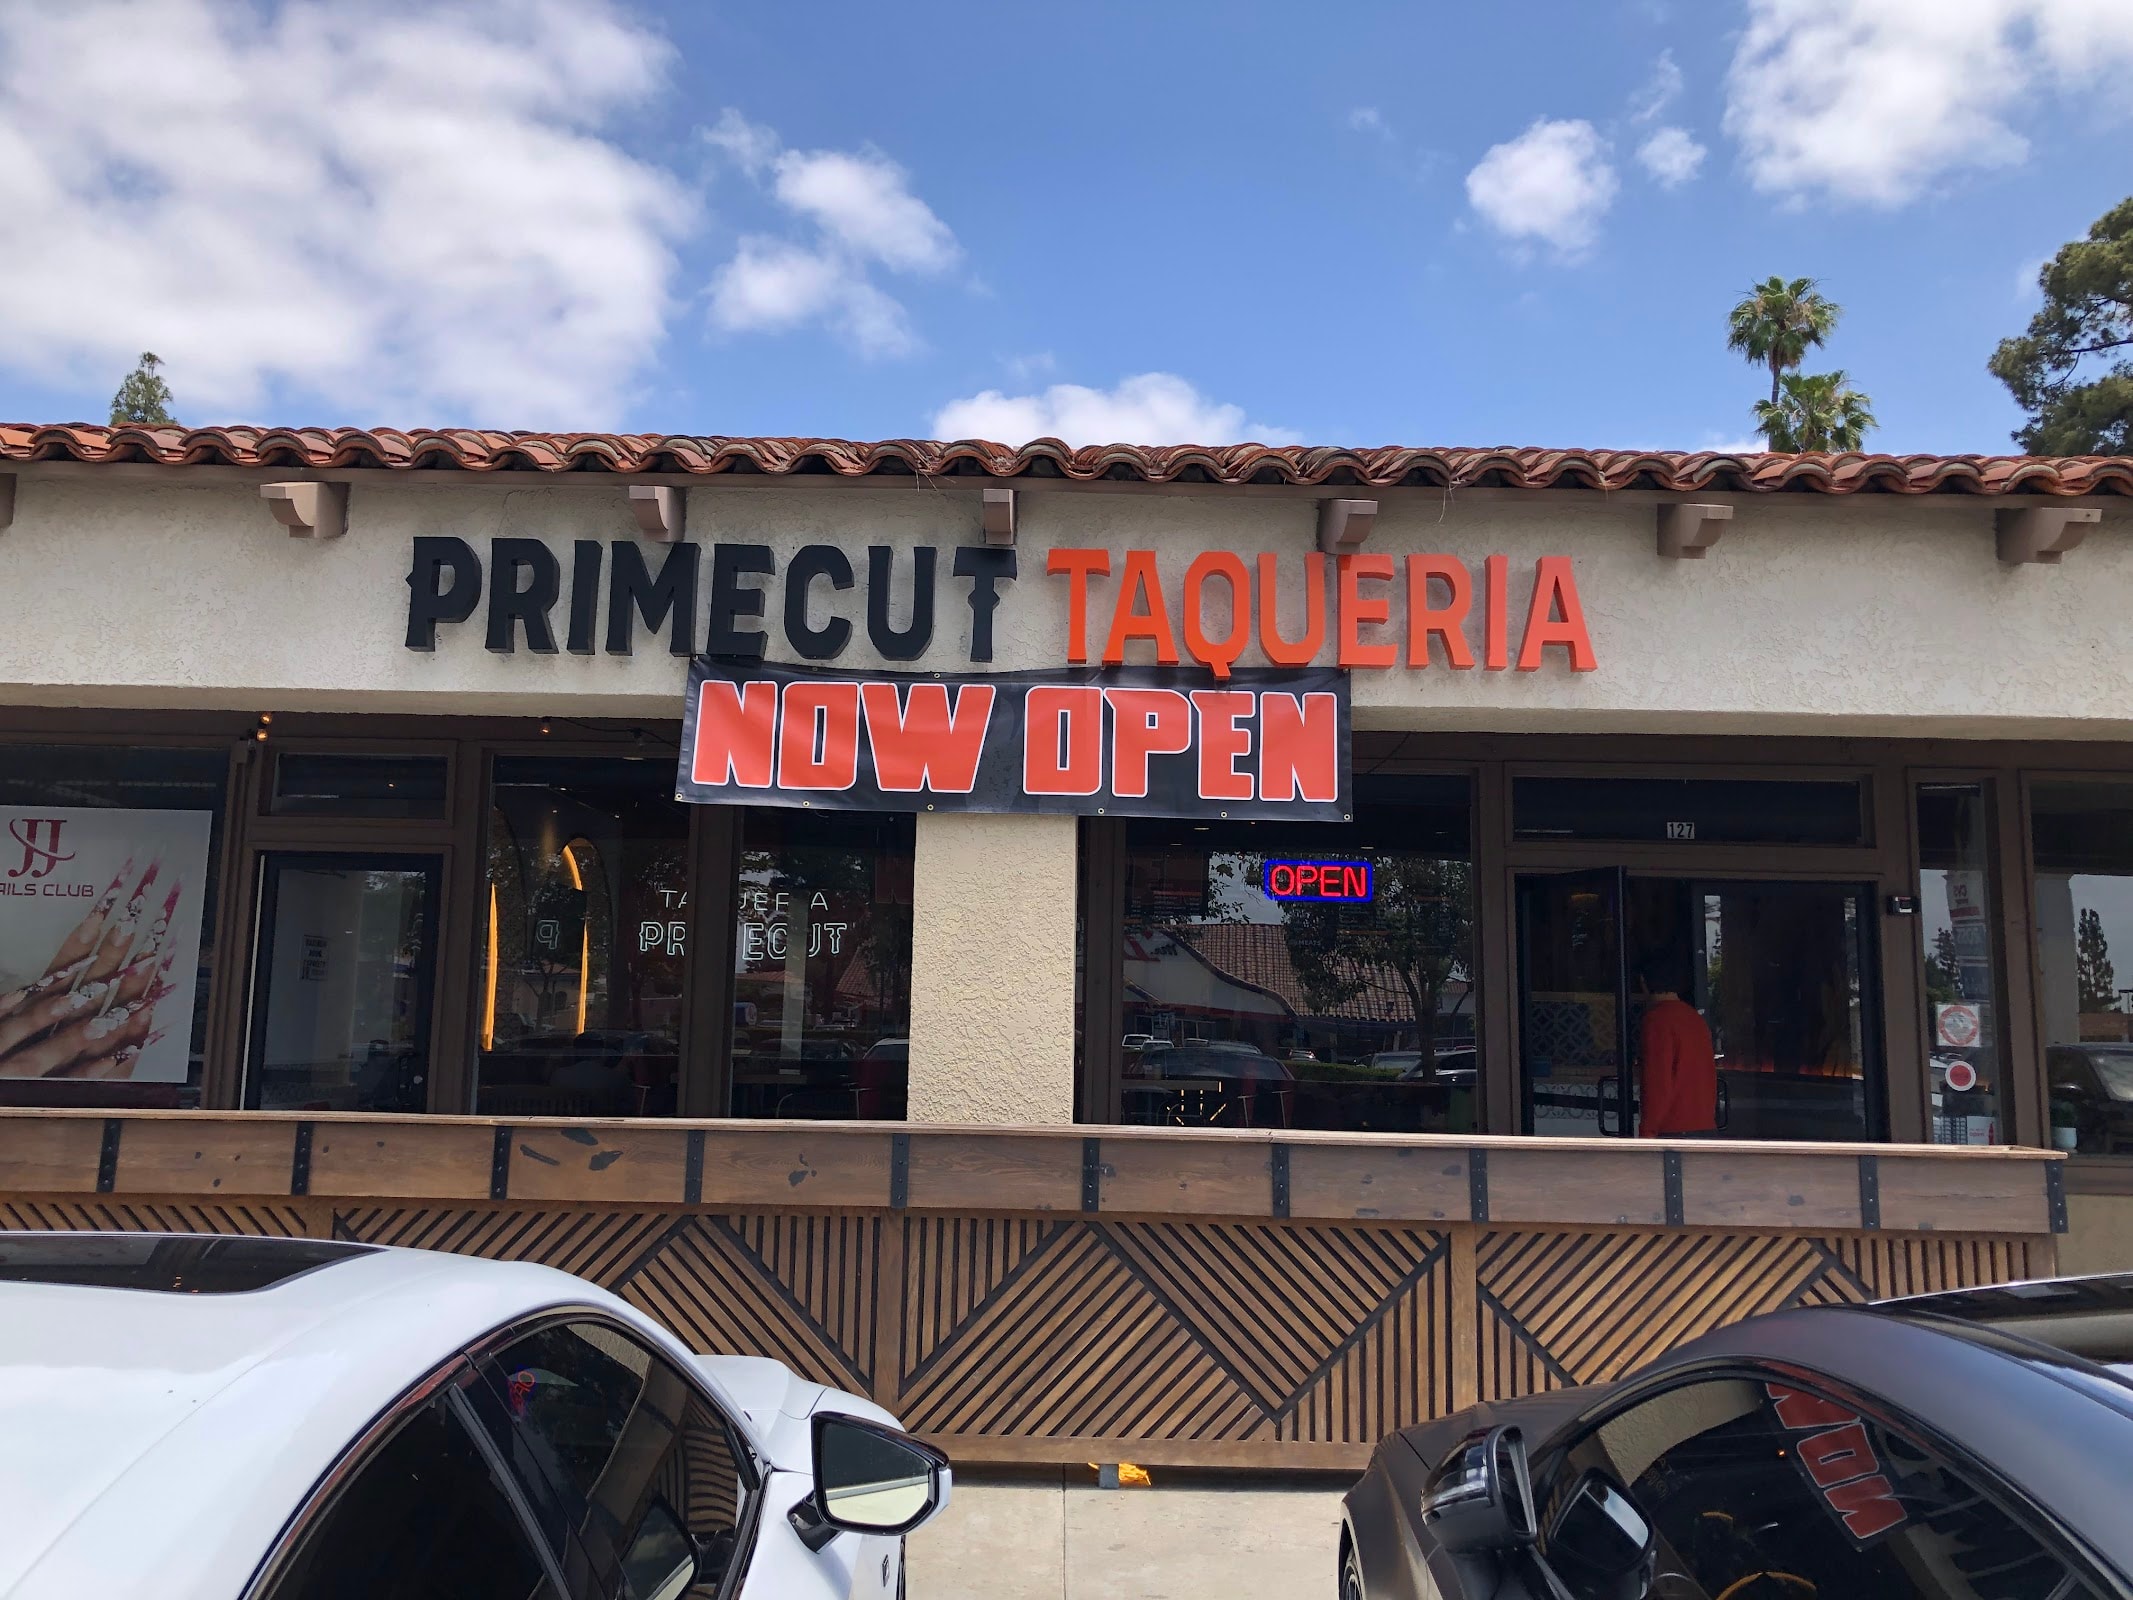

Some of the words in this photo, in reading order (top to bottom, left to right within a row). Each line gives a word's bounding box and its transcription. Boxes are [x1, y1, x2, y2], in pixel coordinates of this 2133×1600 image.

[405, 536, 1017, 663] PRIMECUT
[1047, 549, 1597, 680] TAQUERIA
[691, 680, 996, 792] NOW
[1022, 685, 1337, 802] OPEN
[1669, 822, 1693, 839] 127
[43, 884, 94, 897] CLUB
[1270, 865, 1367, 897] OPEN
